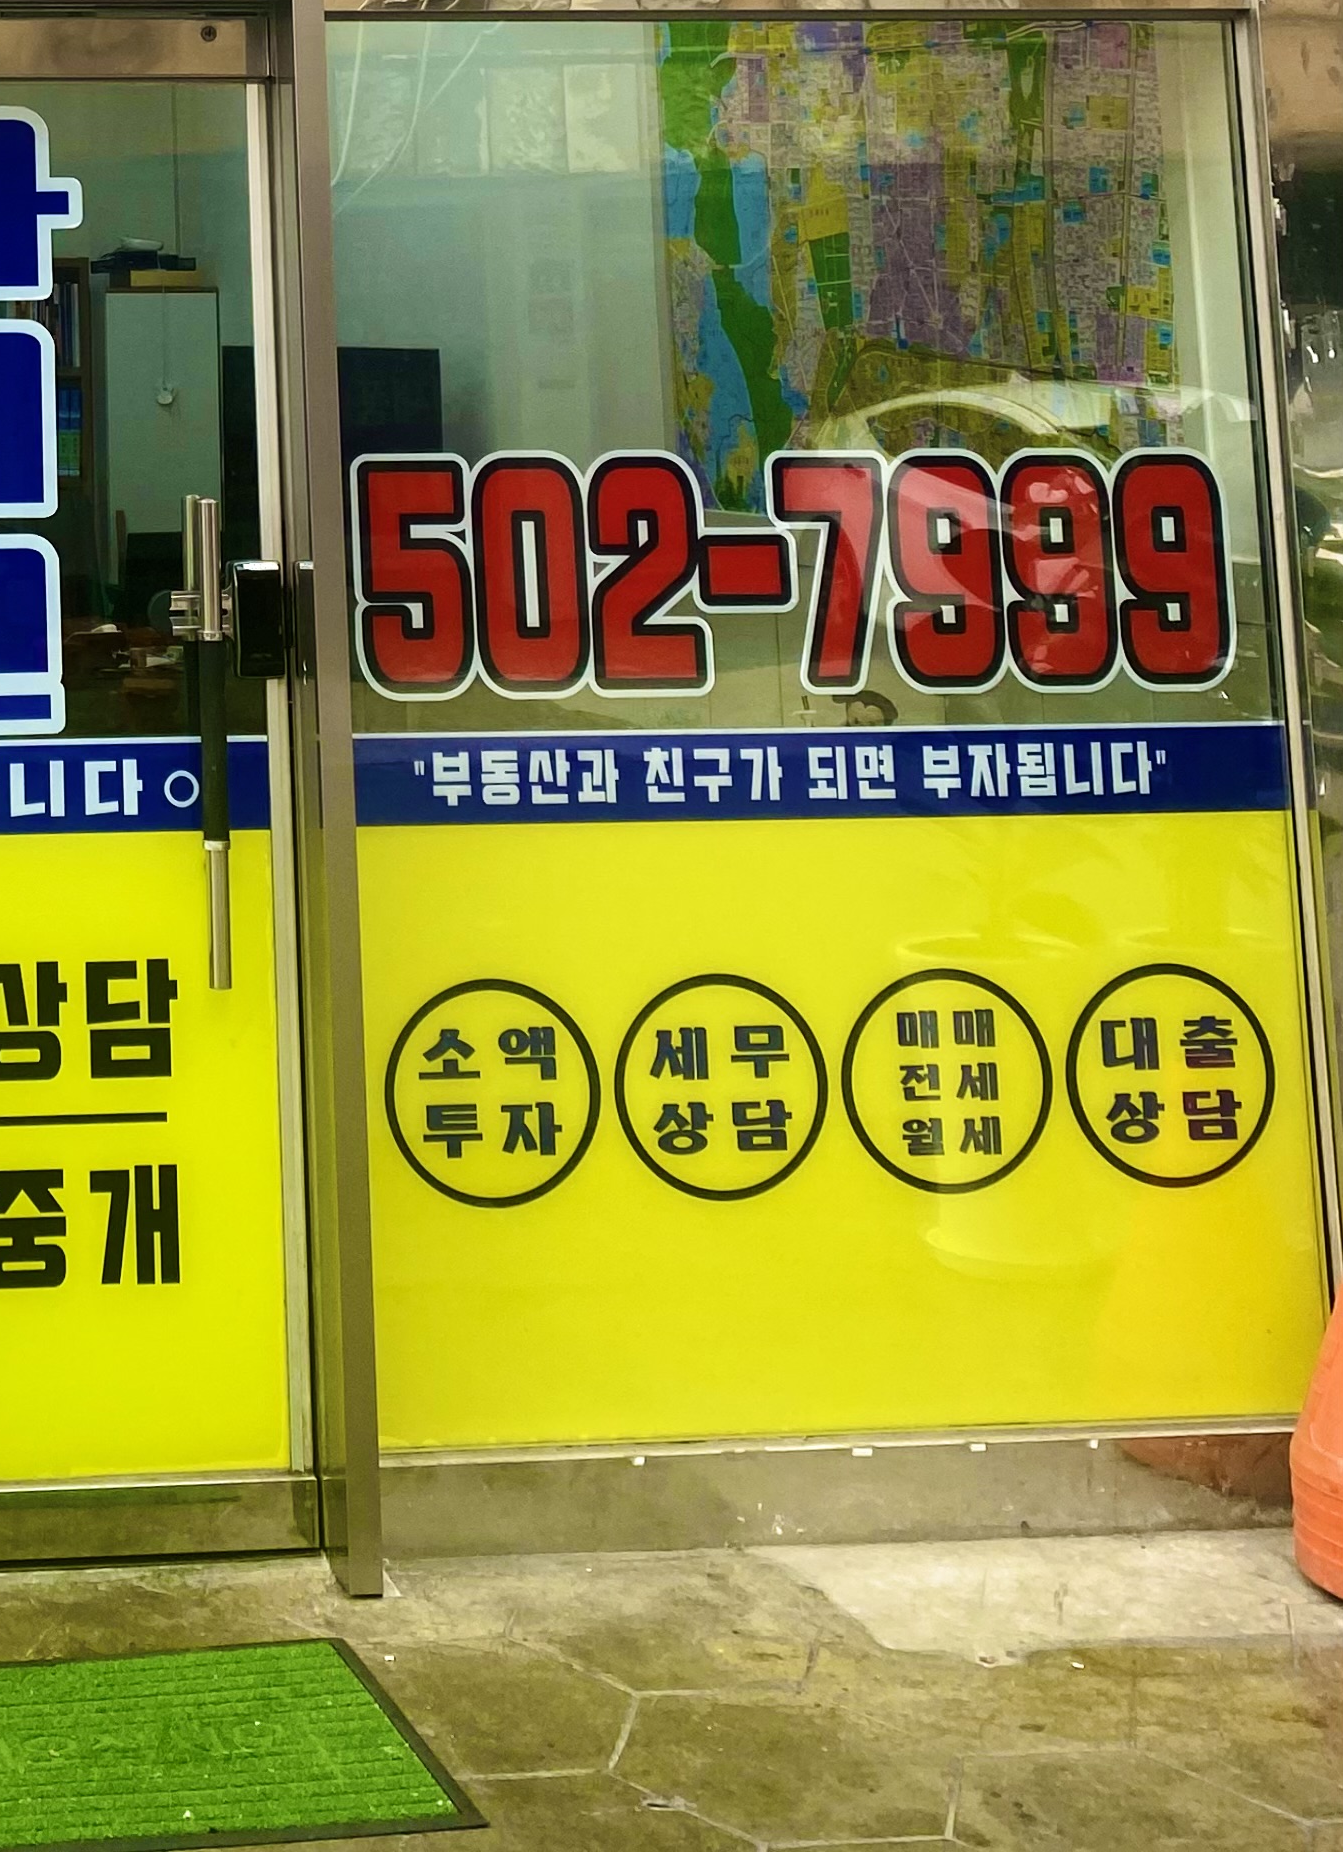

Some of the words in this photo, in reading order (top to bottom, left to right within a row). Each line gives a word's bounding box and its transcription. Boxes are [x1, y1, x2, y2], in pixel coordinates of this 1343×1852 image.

[349, 448, 1236, 700] 502-7999
[643, 747, 782, 803] 친구가
[808, 746, 896, 800] 되면
[417, 1026, 559, 1082] 소액
[651, 1024, 791, 1079] 세무
[896, 1009, 997, 1048] 매매
[1101, 1016, 1239, 1071] 대출
[899, 1061, 1000, 1103] 전세
[421, 1102, 563, 1158] 투자
[652, 1099, 793, 1154] 상담
[901, 1116, 1003, 1155] 월세
[1104, 1090, 1242, 1144] 상담
